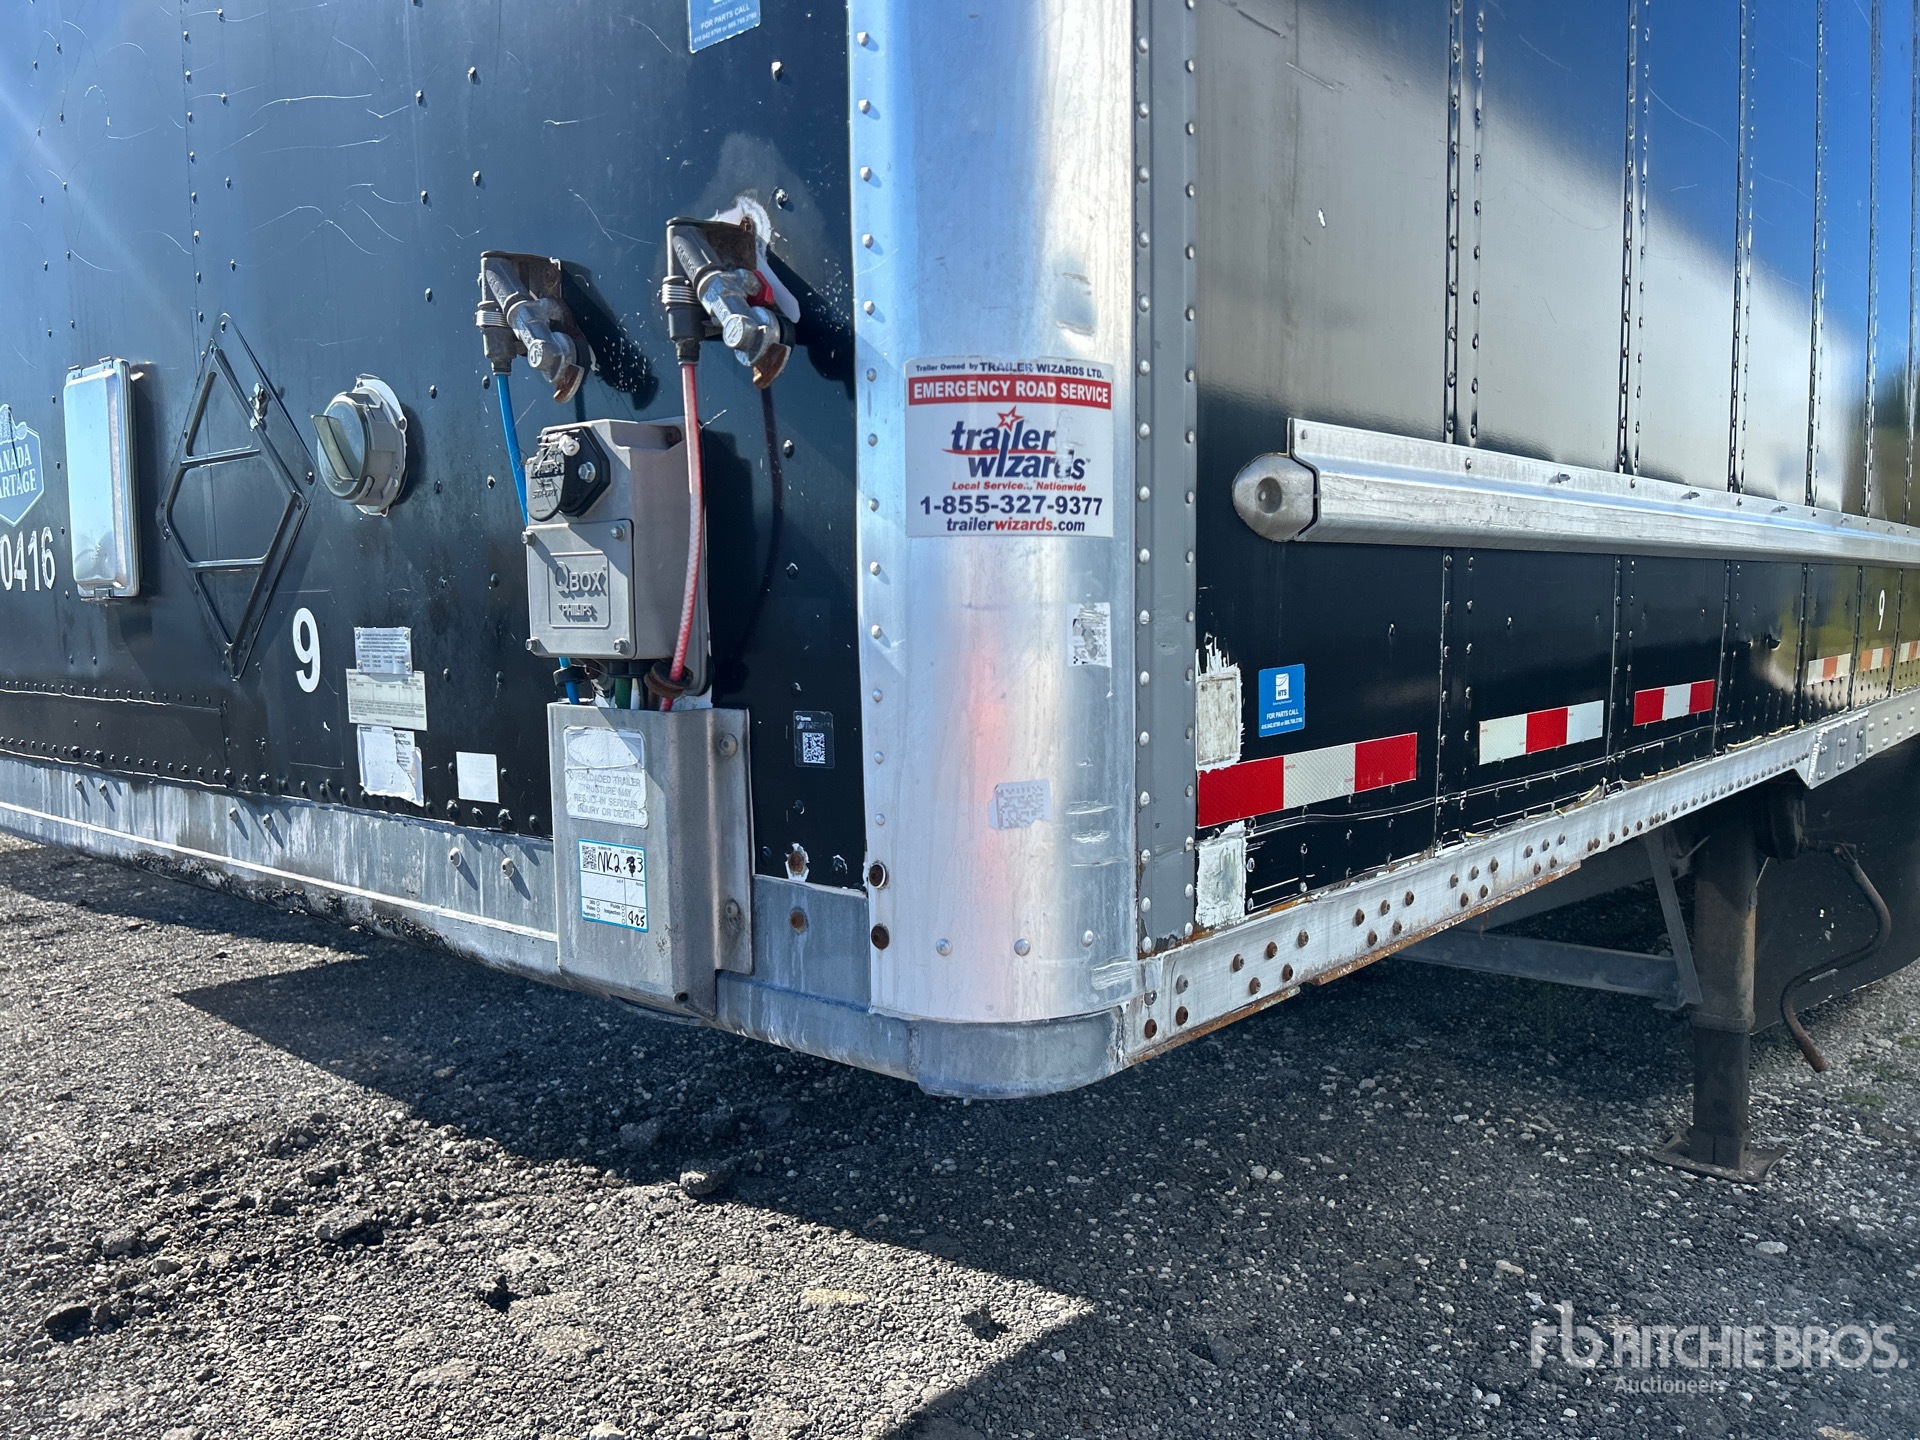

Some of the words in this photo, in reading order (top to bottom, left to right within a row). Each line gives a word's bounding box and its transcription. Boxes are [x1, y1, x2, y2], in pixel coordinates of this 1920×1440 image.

[915, 364, 938, 372] Trailer
[940, 362, 965, 371] Owned
[969, 363, 978, 371] by
[979, 362, 1034, 373] TRAILER
[1036, 363, 1085, 377] WIZARDS
[914, 380, 1011, 400] EMERGENCY
[1015, 380, 1057, 398] ROAD
[1060, 382, 1109, 404] SERVICE
[951, 420, 1057, 452] trailer
[952, 481, 980, 491] Local
[1036, 481, 1087, 492] Nationwide
[920, 494, 1104, 516] 1-855-327-9377
[946, 516, 1086, 533] trailerwizards.com
[1878, 589, 1885, 631] 9
[292, 607, 321, 693] 9
